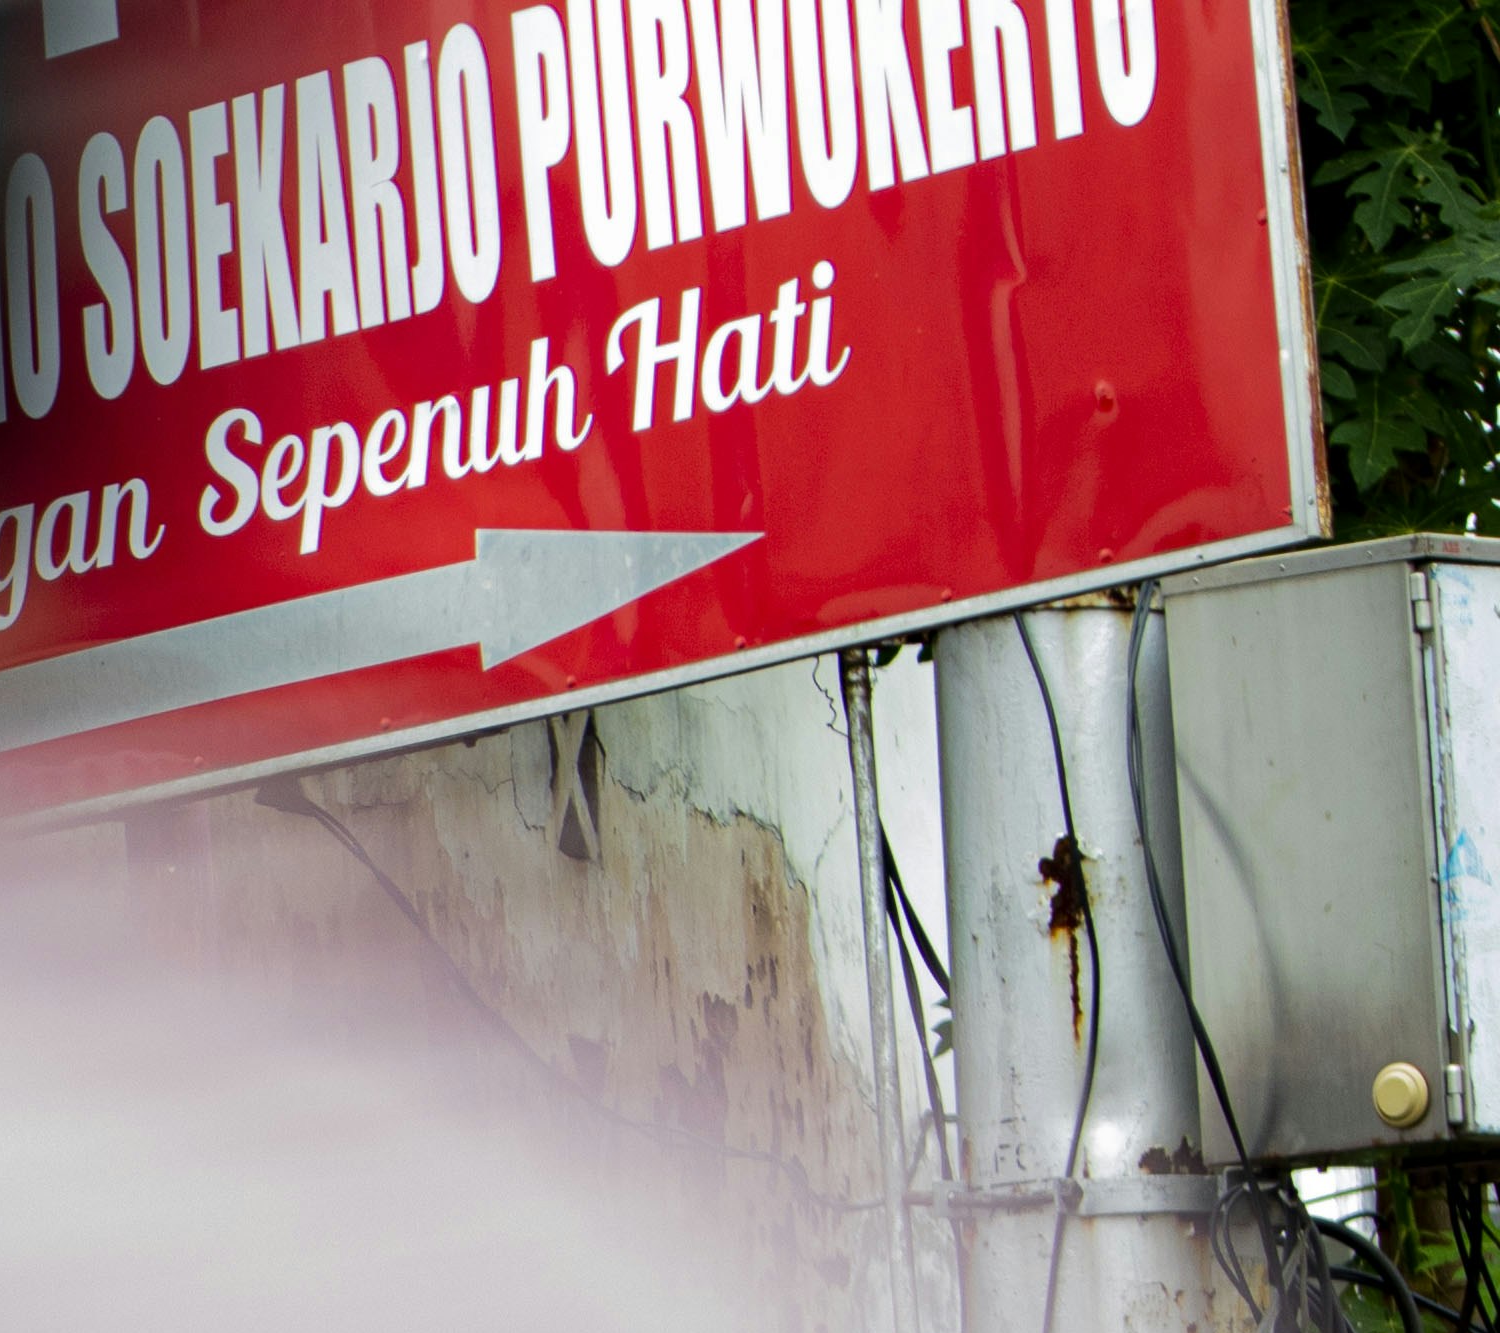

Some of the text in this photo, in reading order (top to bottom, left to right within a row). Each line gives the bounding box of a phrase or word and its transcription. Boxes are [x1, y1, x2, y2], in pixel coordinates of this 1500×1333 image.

[77, 22, 501, 400] SOEKARJO
[198, 336, 593, 556] Sepenuh
[605, 260, 851, 432] Hati
